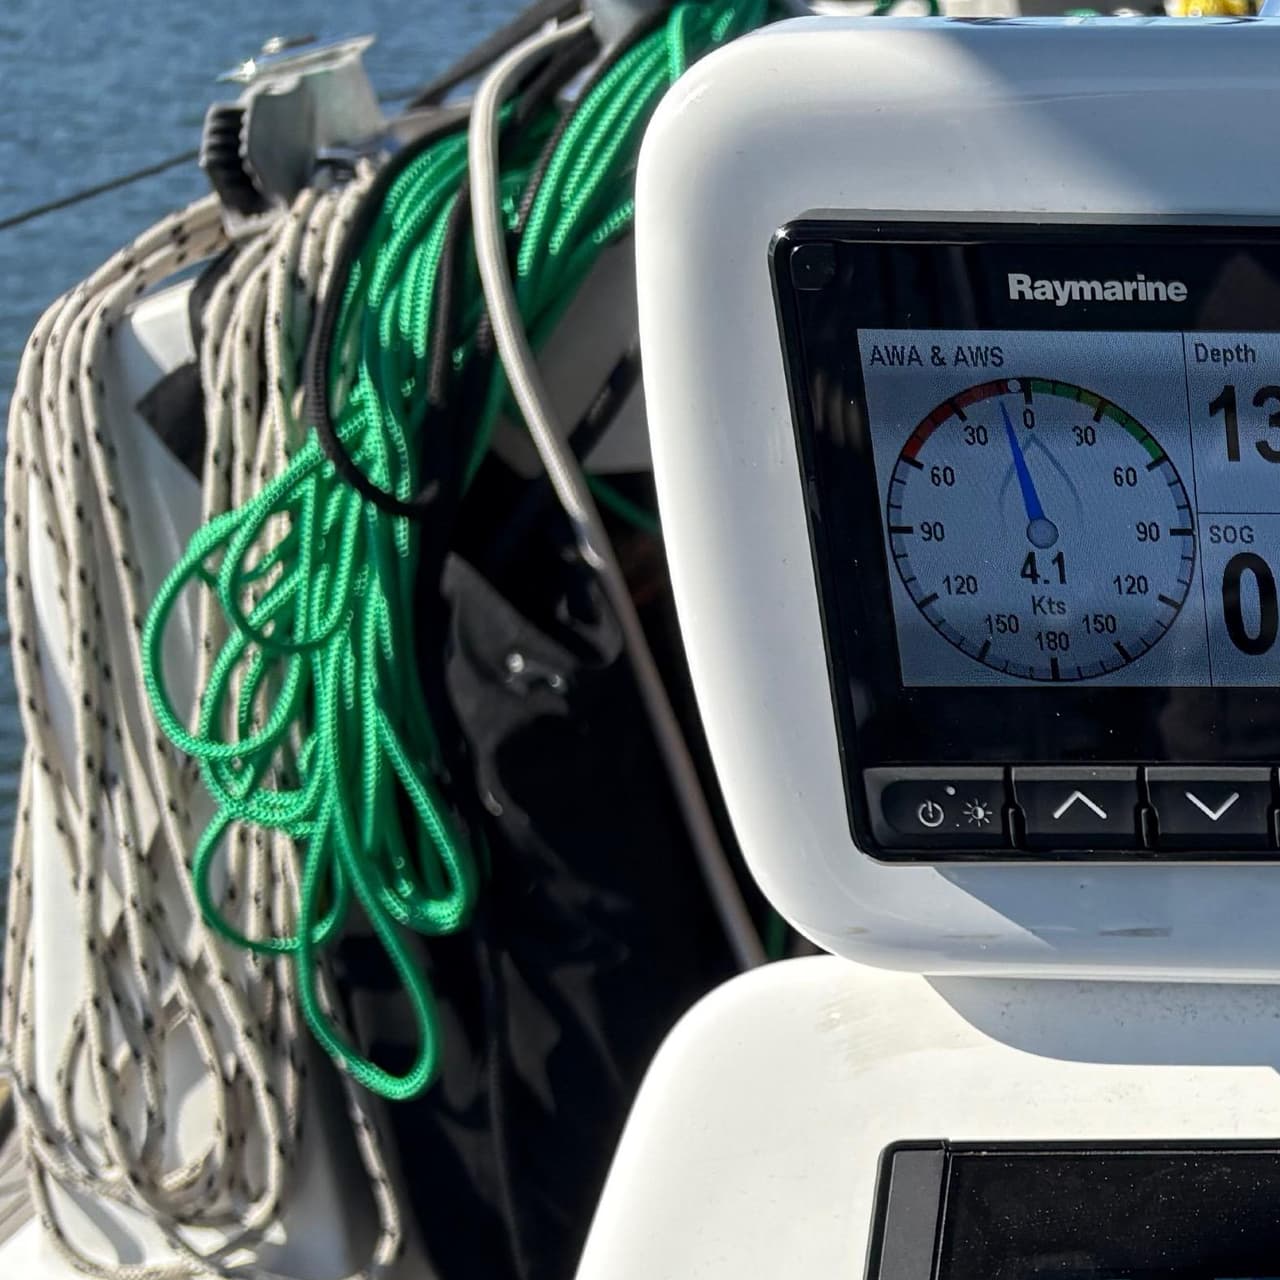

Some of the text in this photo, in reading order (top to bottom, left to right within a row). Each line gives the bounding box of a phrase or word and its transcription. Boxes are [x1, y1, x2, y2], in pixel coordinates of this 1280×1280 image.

[1007, 273, 1188, 306] Raymarine
[869, 345, 1004, 367] AWA & AWS
[1194, 343, 1257, 366] Depth
[1022, 408, 1036, 430] 0
[965, 426, 988, 446] 30
[1073, 426, 1096, 446] 30
[931, 467, 955, 487] 60
[1114, 467, 1137, 487] 60
[921, 522, 945, 542] 90
[1136, 522, 1160, 543] 90
[1208, 524, 1254, 545] SOG
[1020, 552, 1066, 585] 4.1
[942, 576, 978, 595] 120
[1113, 576, 1149, 595] 120
[1032, 596, 1066, 616] Kts
[985, 615, 1019, 635] 150
[1082, 615, 1117, 635] 150
[1035, 631, 1070, 651] 180
